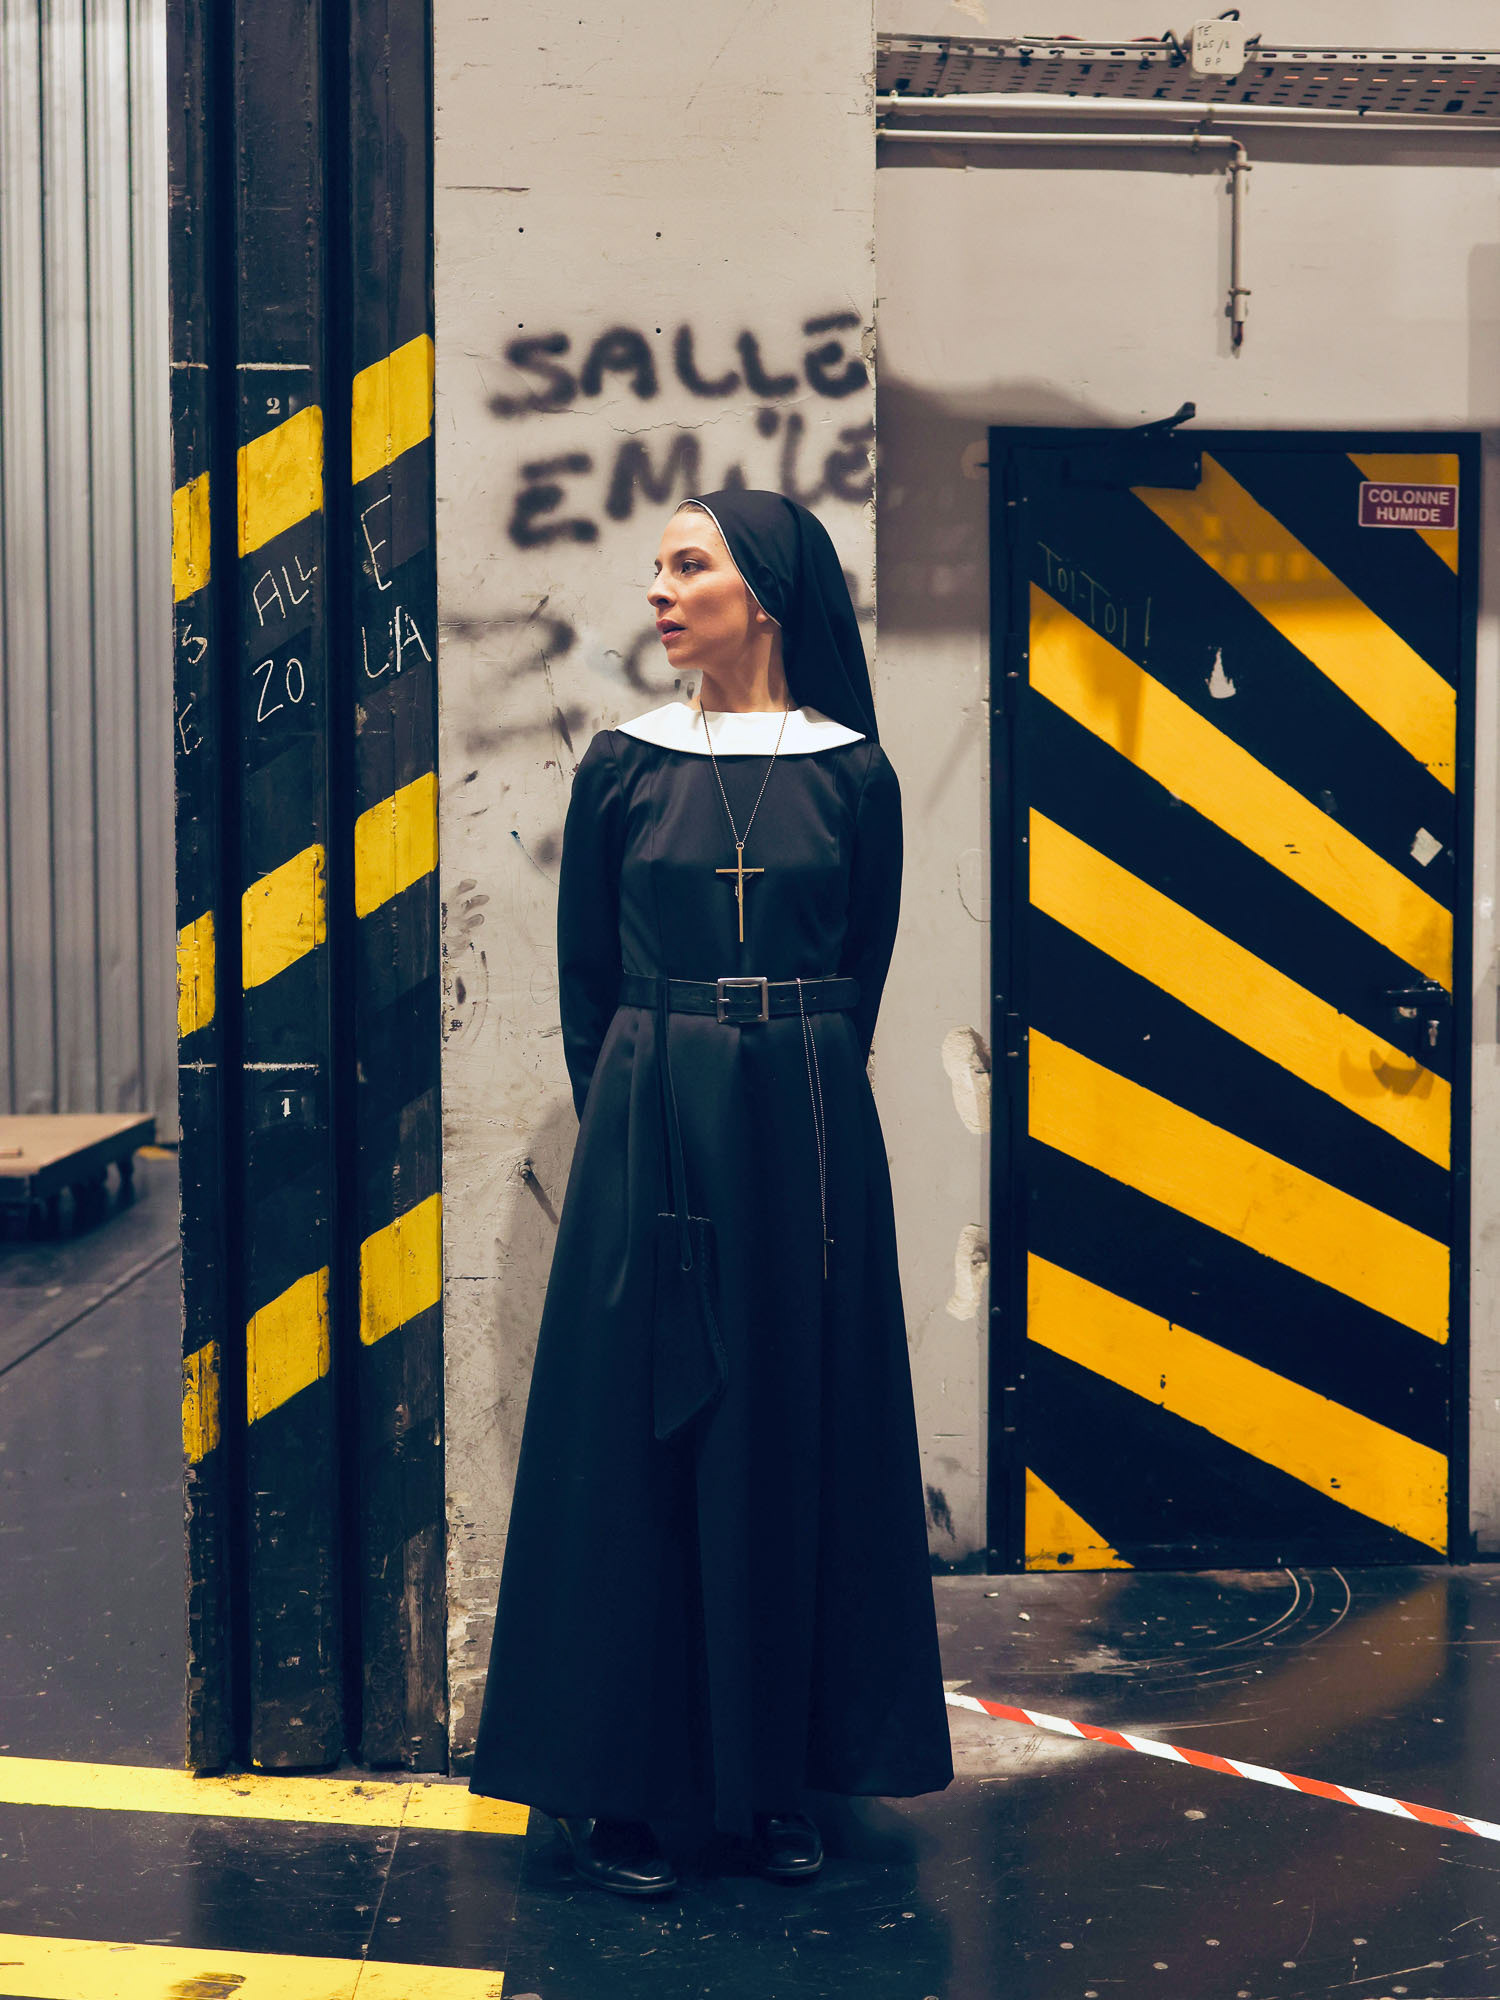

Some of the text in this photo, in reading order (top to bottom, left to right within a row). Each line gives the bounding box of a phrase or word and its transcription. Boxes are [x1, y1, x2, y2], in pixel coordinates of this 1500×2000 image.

[487, 311, 869, 417] SALLE
[266, 397, 280, 415] 2
[1368, 489, 1450, 505] COLONNE
[1376, 506, 1441, 522] HUMIDE
[281, 1097, 291, 1117] 1
